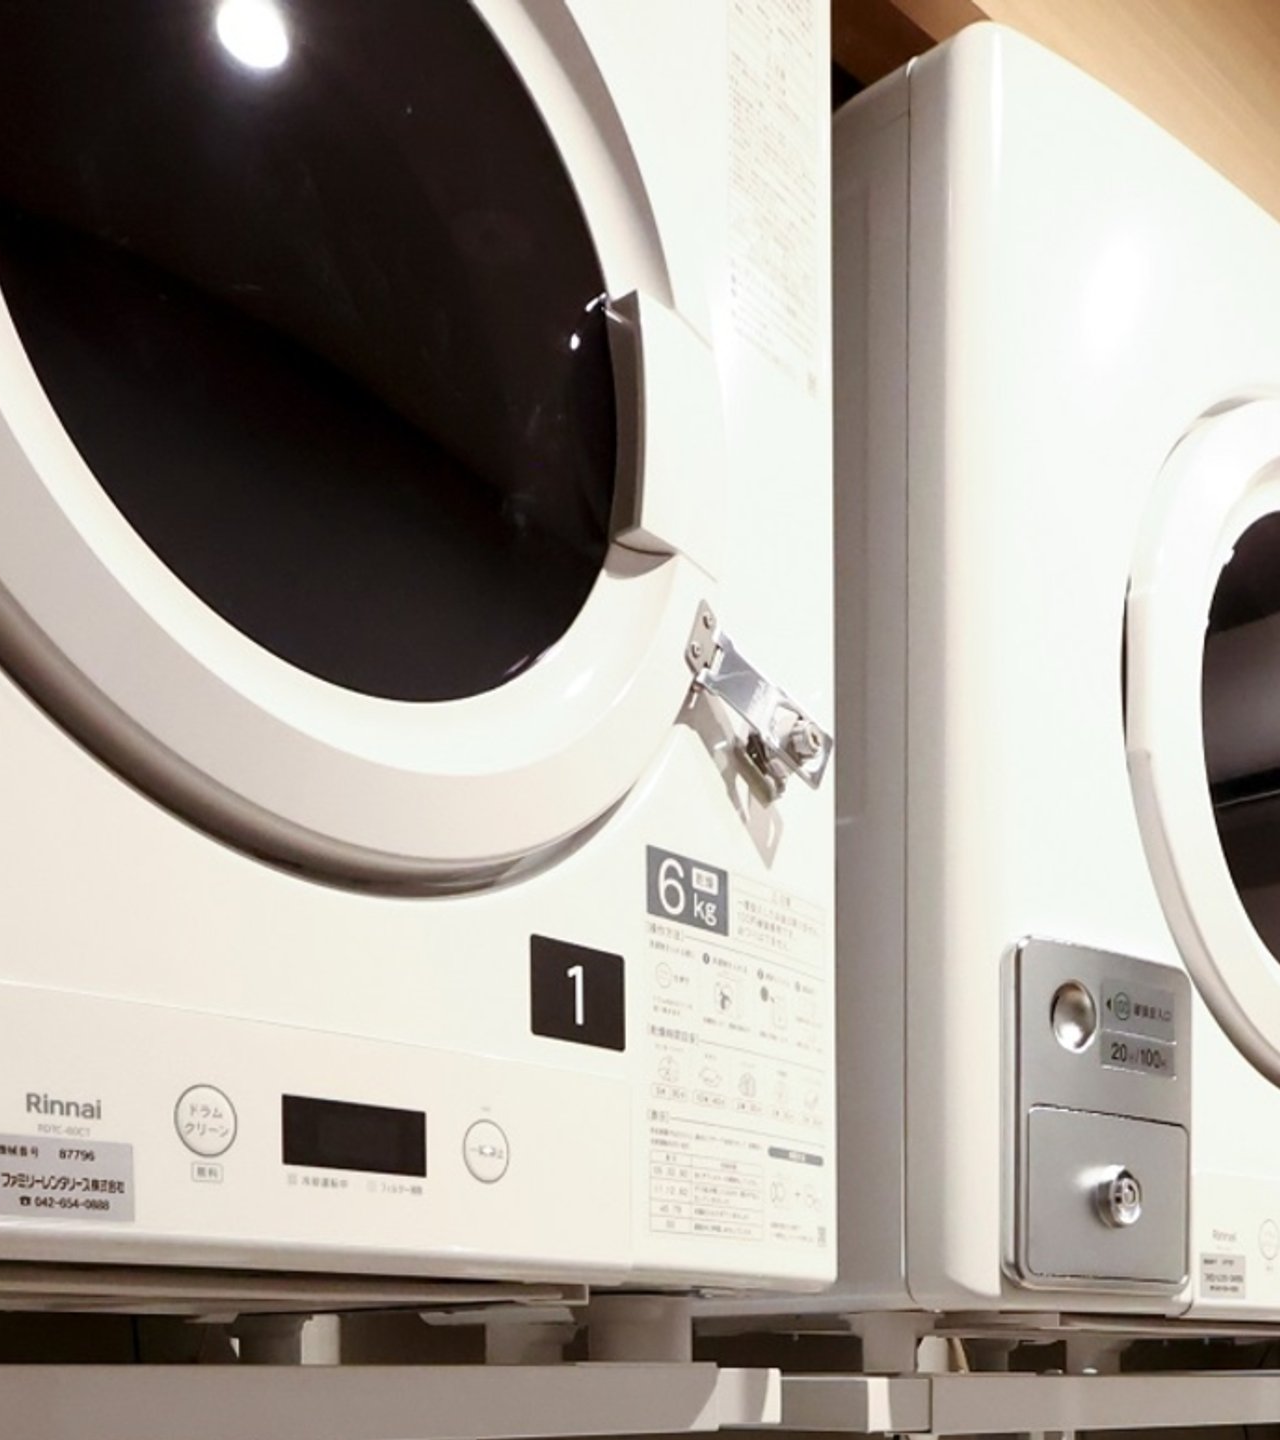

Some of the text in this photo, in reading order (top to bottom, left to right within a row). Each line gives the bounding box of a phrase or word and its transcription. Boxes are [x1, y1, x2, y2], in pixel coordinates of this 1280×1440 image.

[659, 858, 686, 915] 6
[693, 893, 717, 926] kg
[567, 965, 584, 1025] 1
[26, 1093, 101, 1119] Rinnai
[184, 1121, 229, 1138] クリーン
[59, 1148, 95, 1162] 87796
